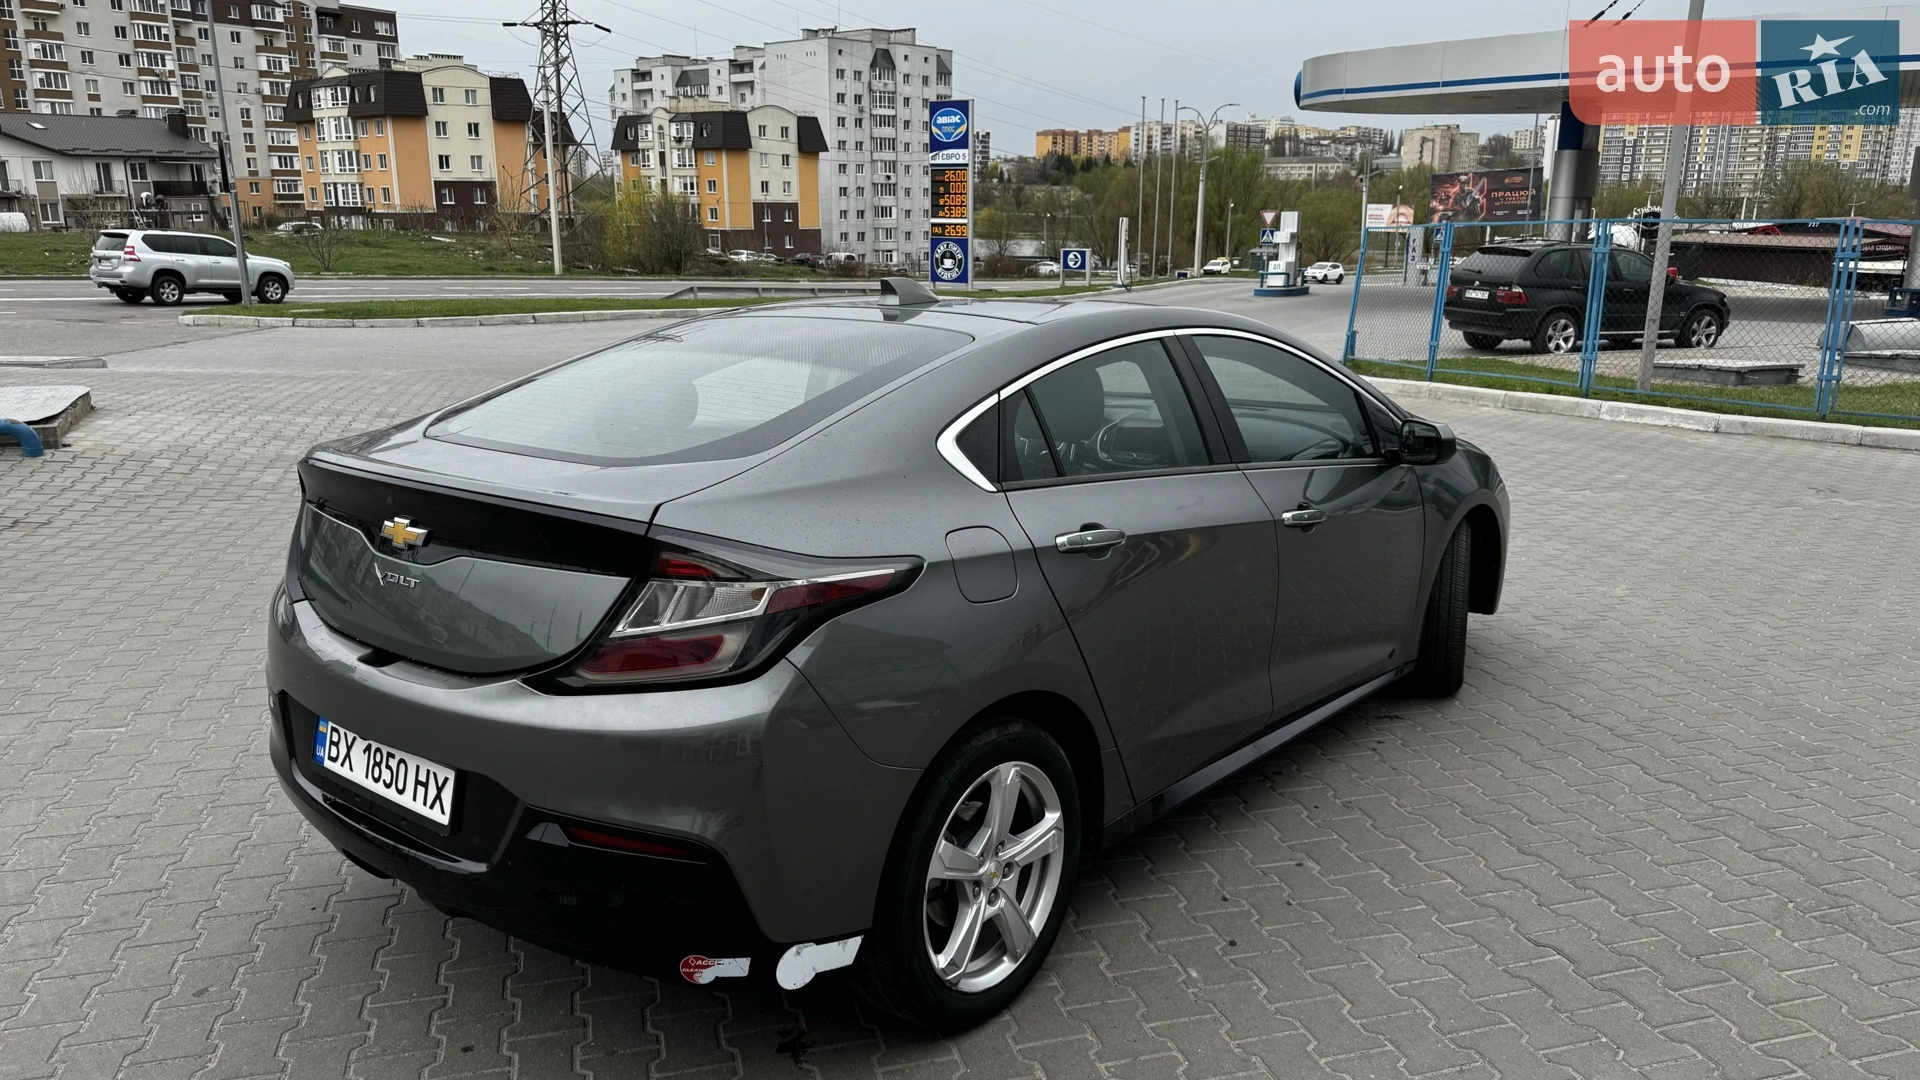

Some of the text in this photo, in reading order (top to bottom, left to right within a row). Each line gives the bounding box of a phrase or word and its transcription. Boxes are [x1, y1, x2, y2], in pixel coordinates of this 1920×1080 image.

[941, 152, 960, 161] ЄВРО
[961, 152, 967, 161] 5
[1491, 188, 1536, 198] ПРАЦЮЙ
[374, 562, 421, 588] VOLT
[316, 745, 325, 757] UA
[327, 725, 449, 816] BX 1850 HX
